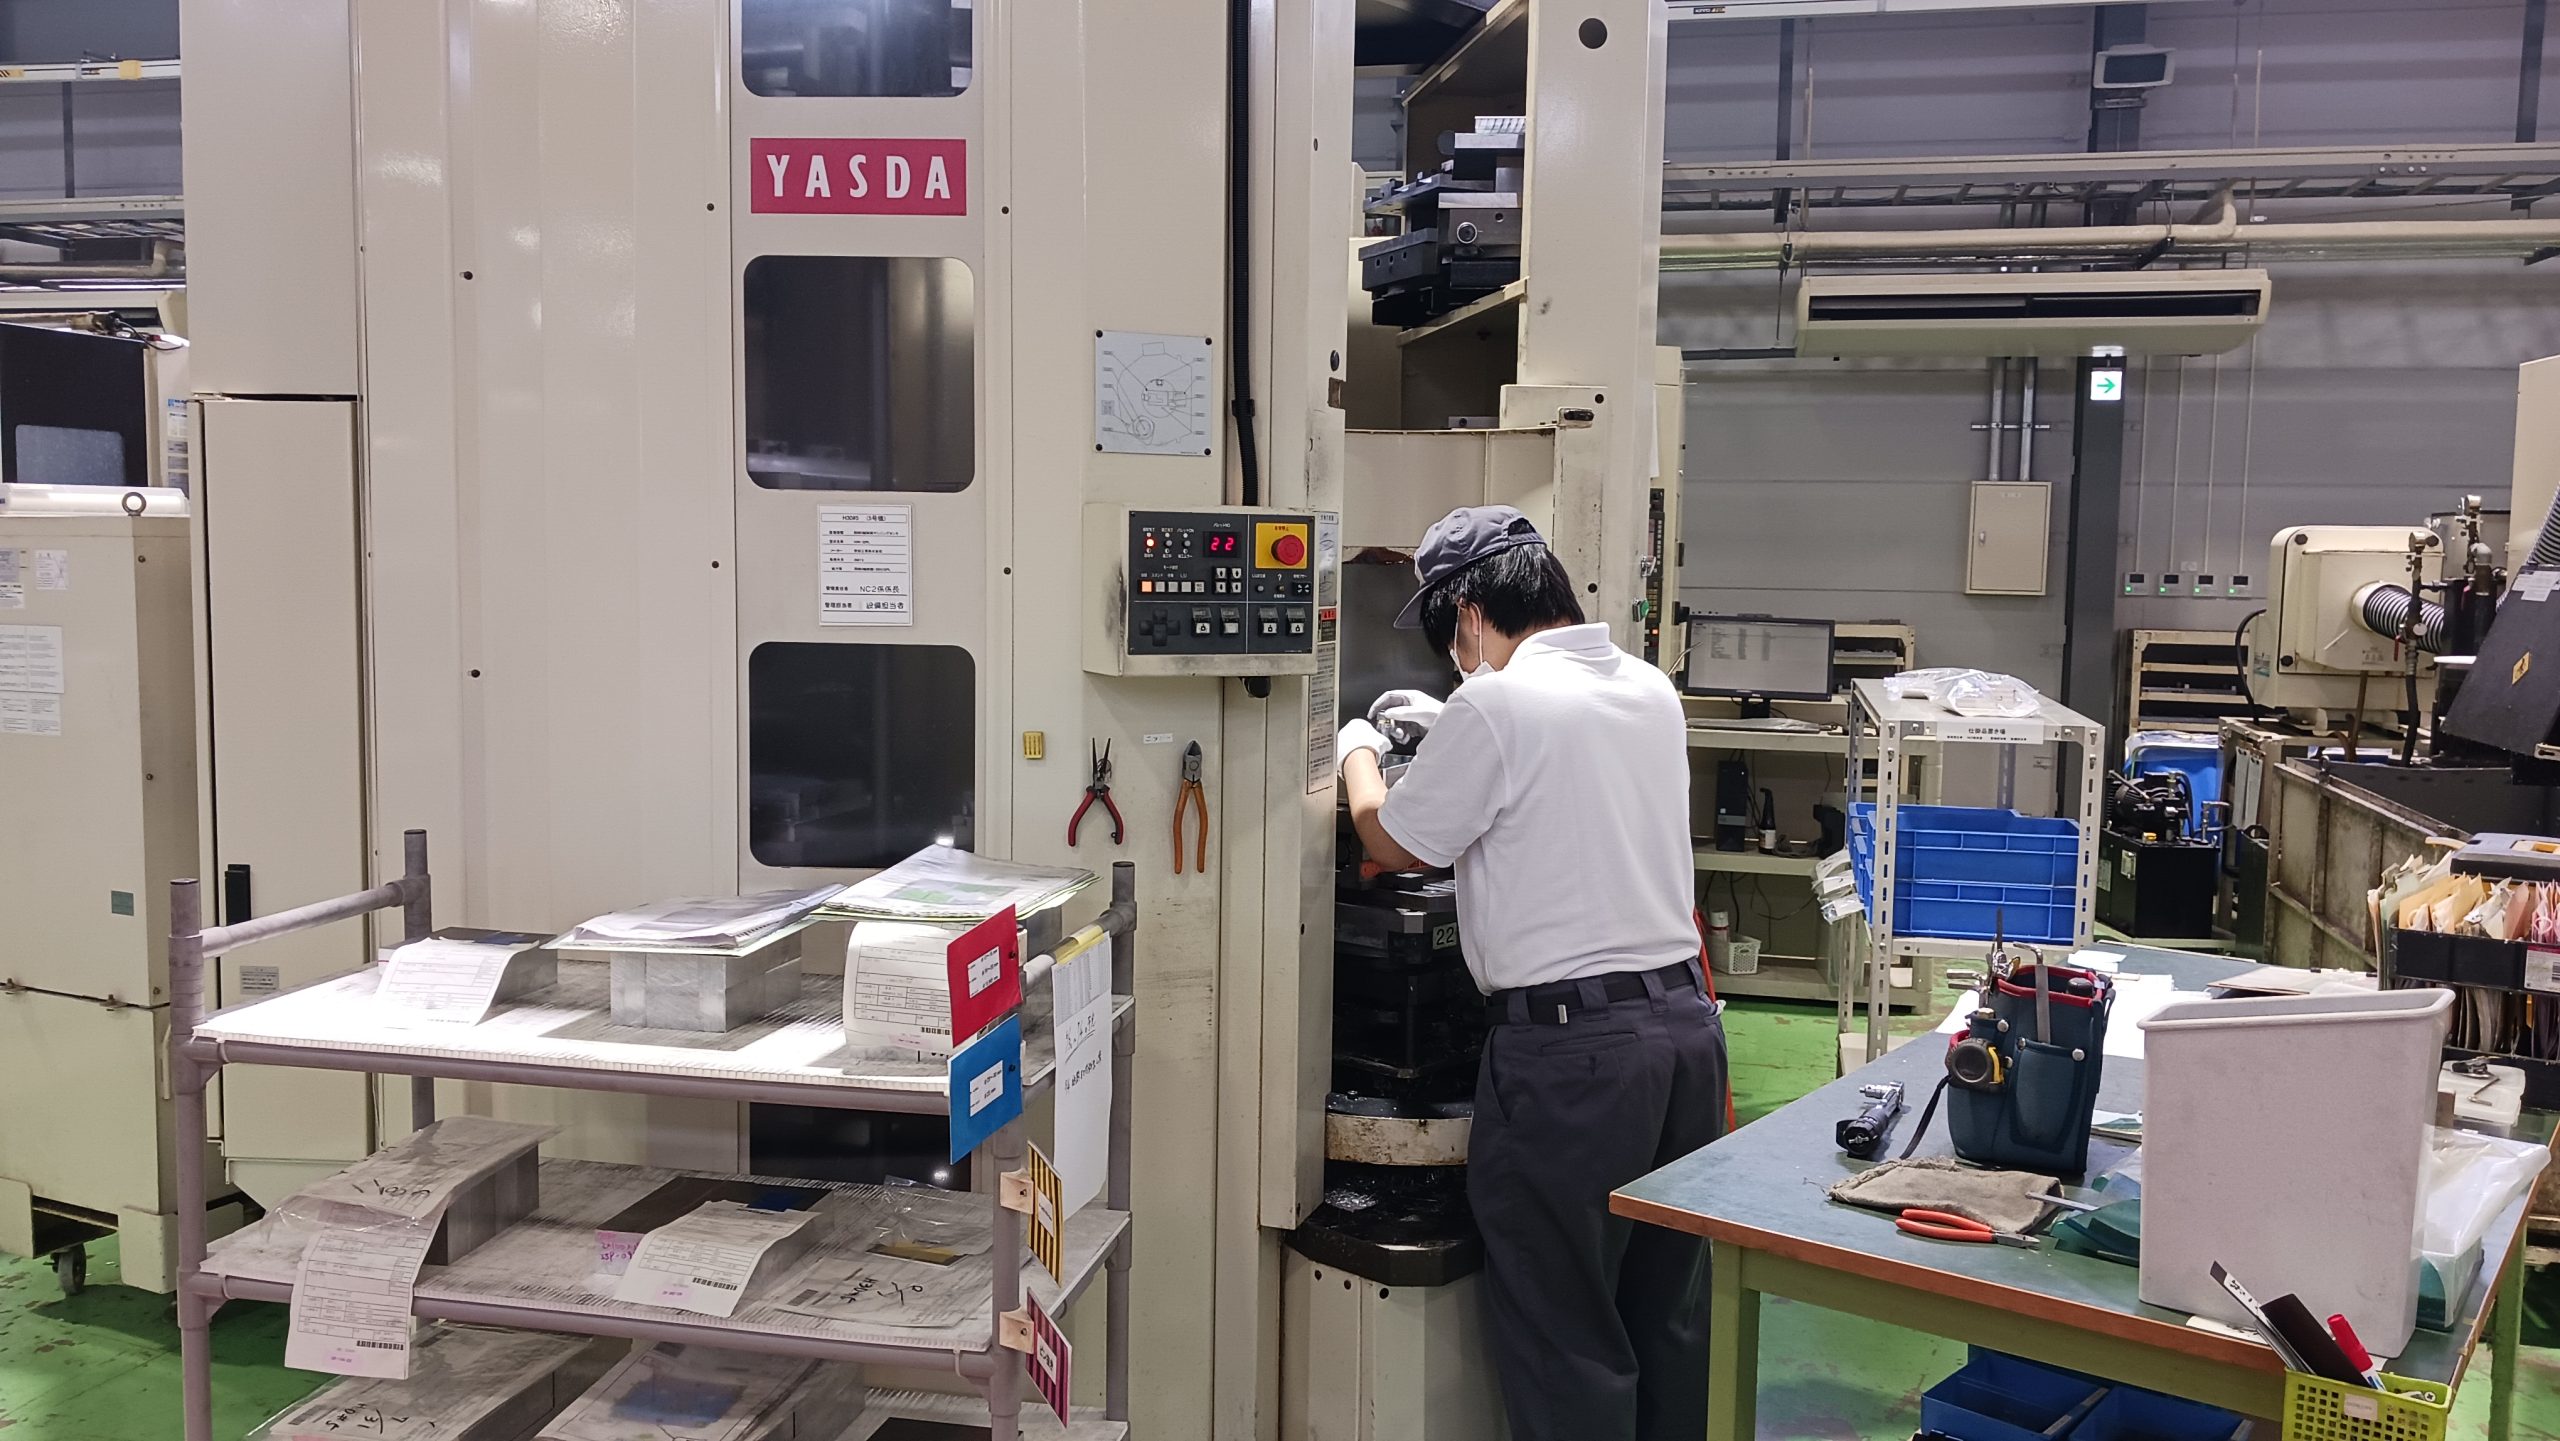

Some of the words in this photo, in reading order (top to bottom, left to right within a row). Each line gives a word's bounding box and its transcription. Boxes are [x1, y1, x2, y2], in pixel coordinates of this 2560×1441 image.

[766, 154, 951, 199] YASDA
[1211, 537, 1235, 551] 22
[1436, 926, 1455, 946] 22
